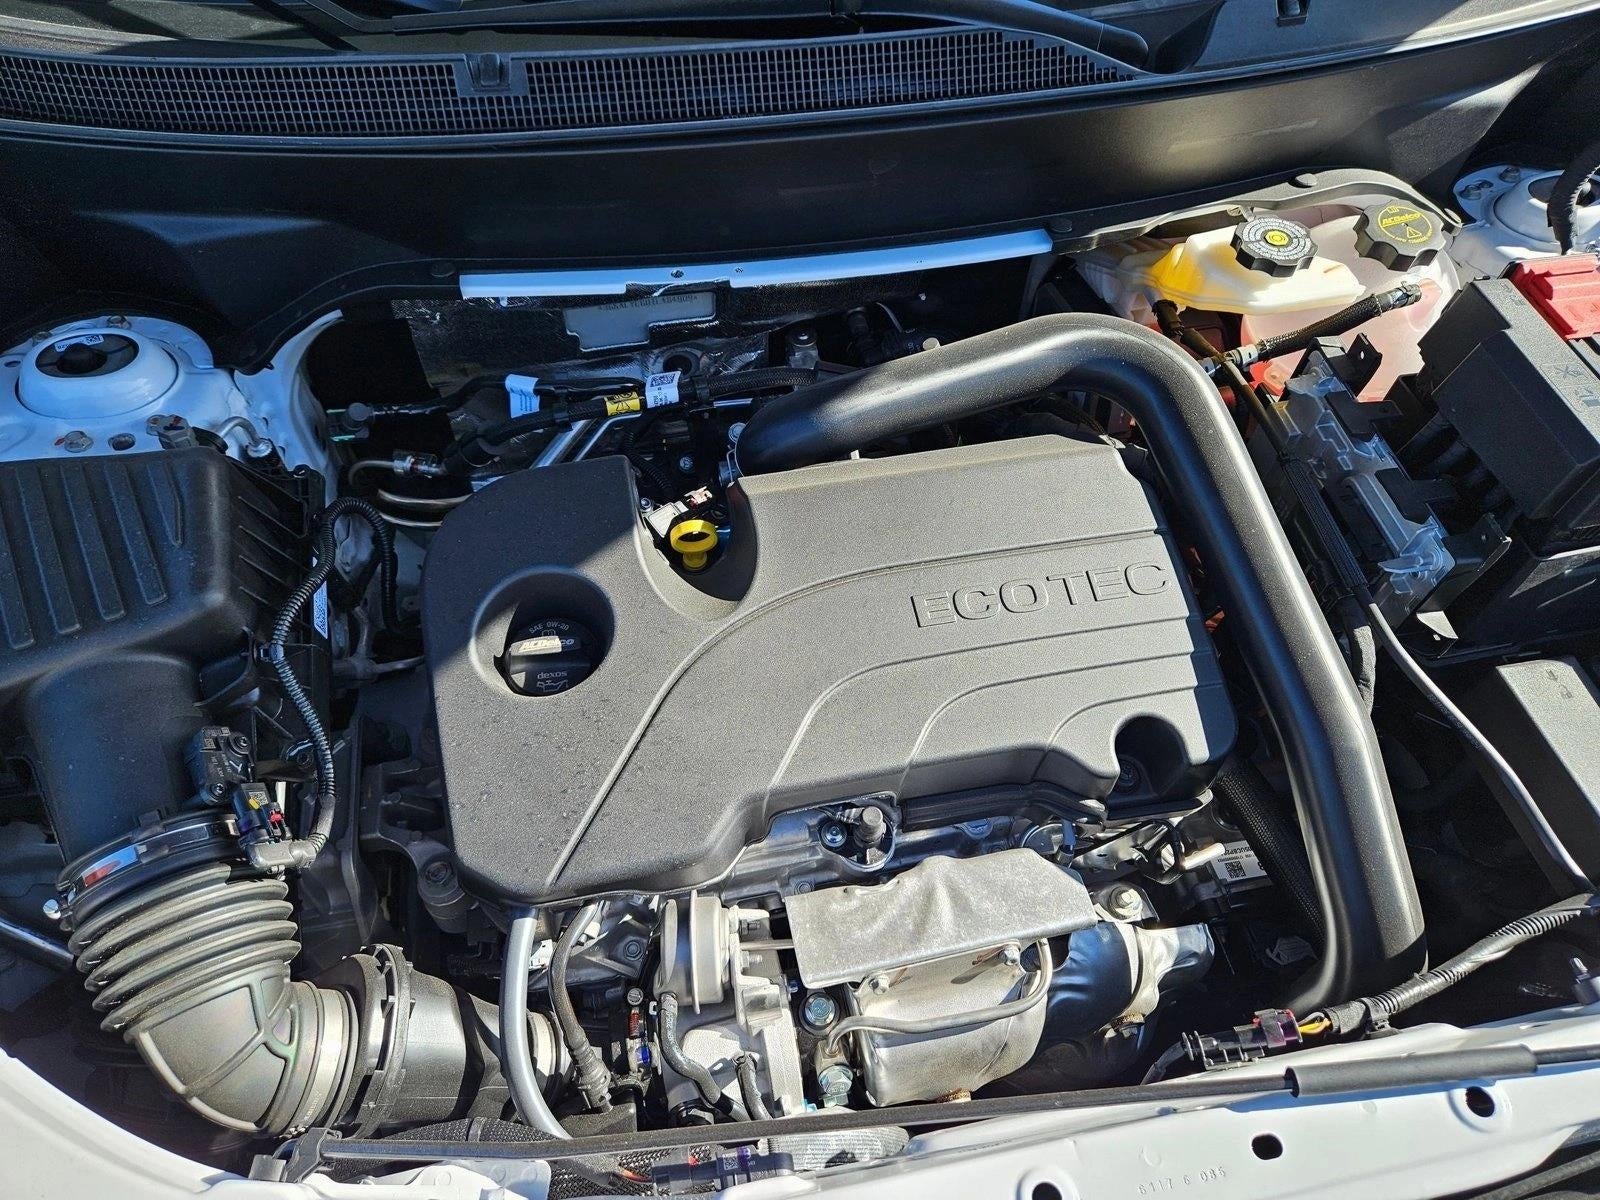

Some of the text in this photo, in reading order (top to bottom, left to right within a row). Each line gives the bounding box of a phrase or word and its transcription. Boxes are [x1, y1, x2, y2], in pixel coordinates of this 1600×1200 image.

[910, 560, 1171, 628] ECOTEC
[528, 623, 544, 635] SAE
[537, 670, 568, 680] dexos
